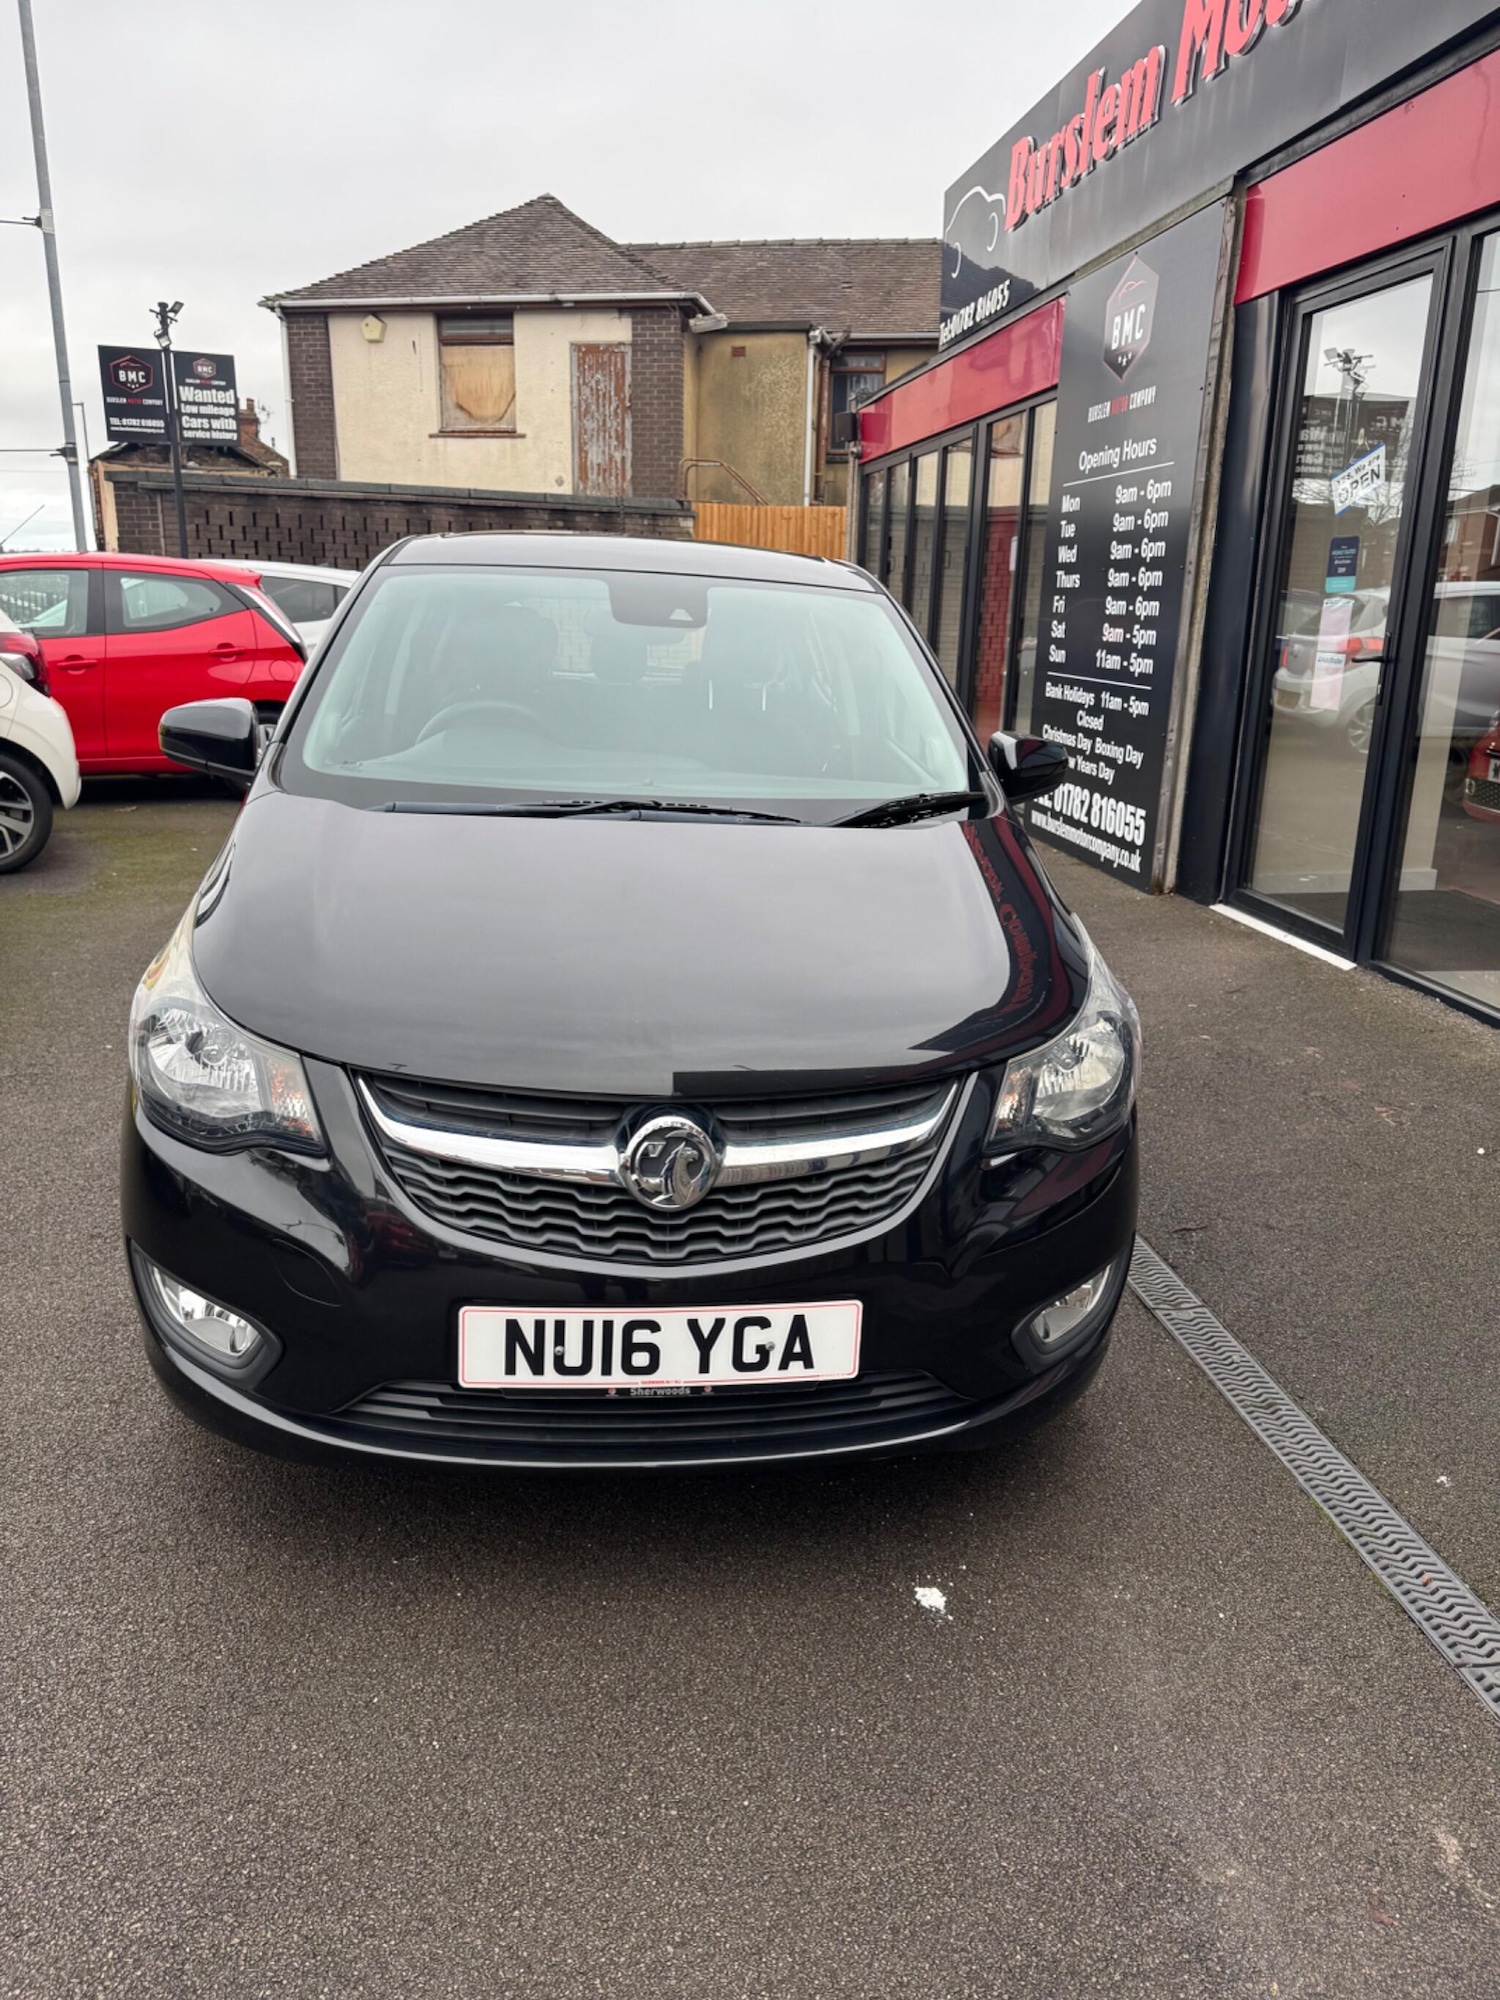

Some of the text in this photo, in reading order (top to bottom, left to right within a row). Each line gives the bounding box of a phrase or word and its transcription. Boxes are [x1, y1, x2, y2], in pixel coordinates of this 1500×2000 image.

[1004, 0, 1297, 232] Burslem Mo
[976, 279, 1010, 322] 816055
[1111, 303, 1146, 350] BMC
[118, 370, 146, 383] BMC
[179, 385, 235, 404] Wanted
[181, 403, 235, 416] Low mileage
[182, 415, 237, 430] Cars with
[183, 429, 238, 441] service history
[1079, 438, 1157, 474] Opening Hours
[1061, 494, 1080, 513] Mon
[1115, 485, 1138, 504] 9am
[1146, 479, 1172, 504] 6pm
[1338, 464, 1380, 504] OPEN
[1060, 520, 1076, 538] Tue
[1112, 512, 1135, 532] 9am
[1143, 508, 1169, 533] 6pm
[1058, 544, 1078, 563] Wed
[1110, 540, 1132, 560] 9am
[1140, 537, 1166, 562] 6pm
[1056, 570, 1080, 588] Thurs
[1107, 567, 1130, 588] 9am
[1138, 566, 1163, 592] 6pm
[1052, 595, 1066, 613] Fri
[1105, 595, 1127, 615] 9am
[1135, 595, 1160, 621] 6pm
[1051, 620, 1066, 639] Sat
[1102, 622, 1124, 643] 9am
[1132, 624, 1157, 650] 5pm
[1048, 644, 1066, 664] Sun
[1096, 648, 1121, 670] 11am
[1129, 652, 1154, 677] 5pm
[1045, 681, 1063, 699] Bank
[1063, 684, 1095, 709] Holidays
[1101, 691, 1122, 711] 11am
[1129, 695, 1149, 718] 5pm
[1076, 710, 1104, 731] Closed
[1042, 724, 1077, 747] Christmas
[1077, 732, 1093, 755] Day
[1095, 737, 1125, 765] Boxing
[1125, 744, 1144, 770] Day
[1076, 755, 1097, 776] Years
[1098, 762, 1115, 785] Day
[1053, 782, 1091, 823] 01782
[1091, 792, 1146, 846] 816055
[504, 1313, 815, 1376] NU16 YGA
[629, 1386, 692, 1397] Sherwoods
